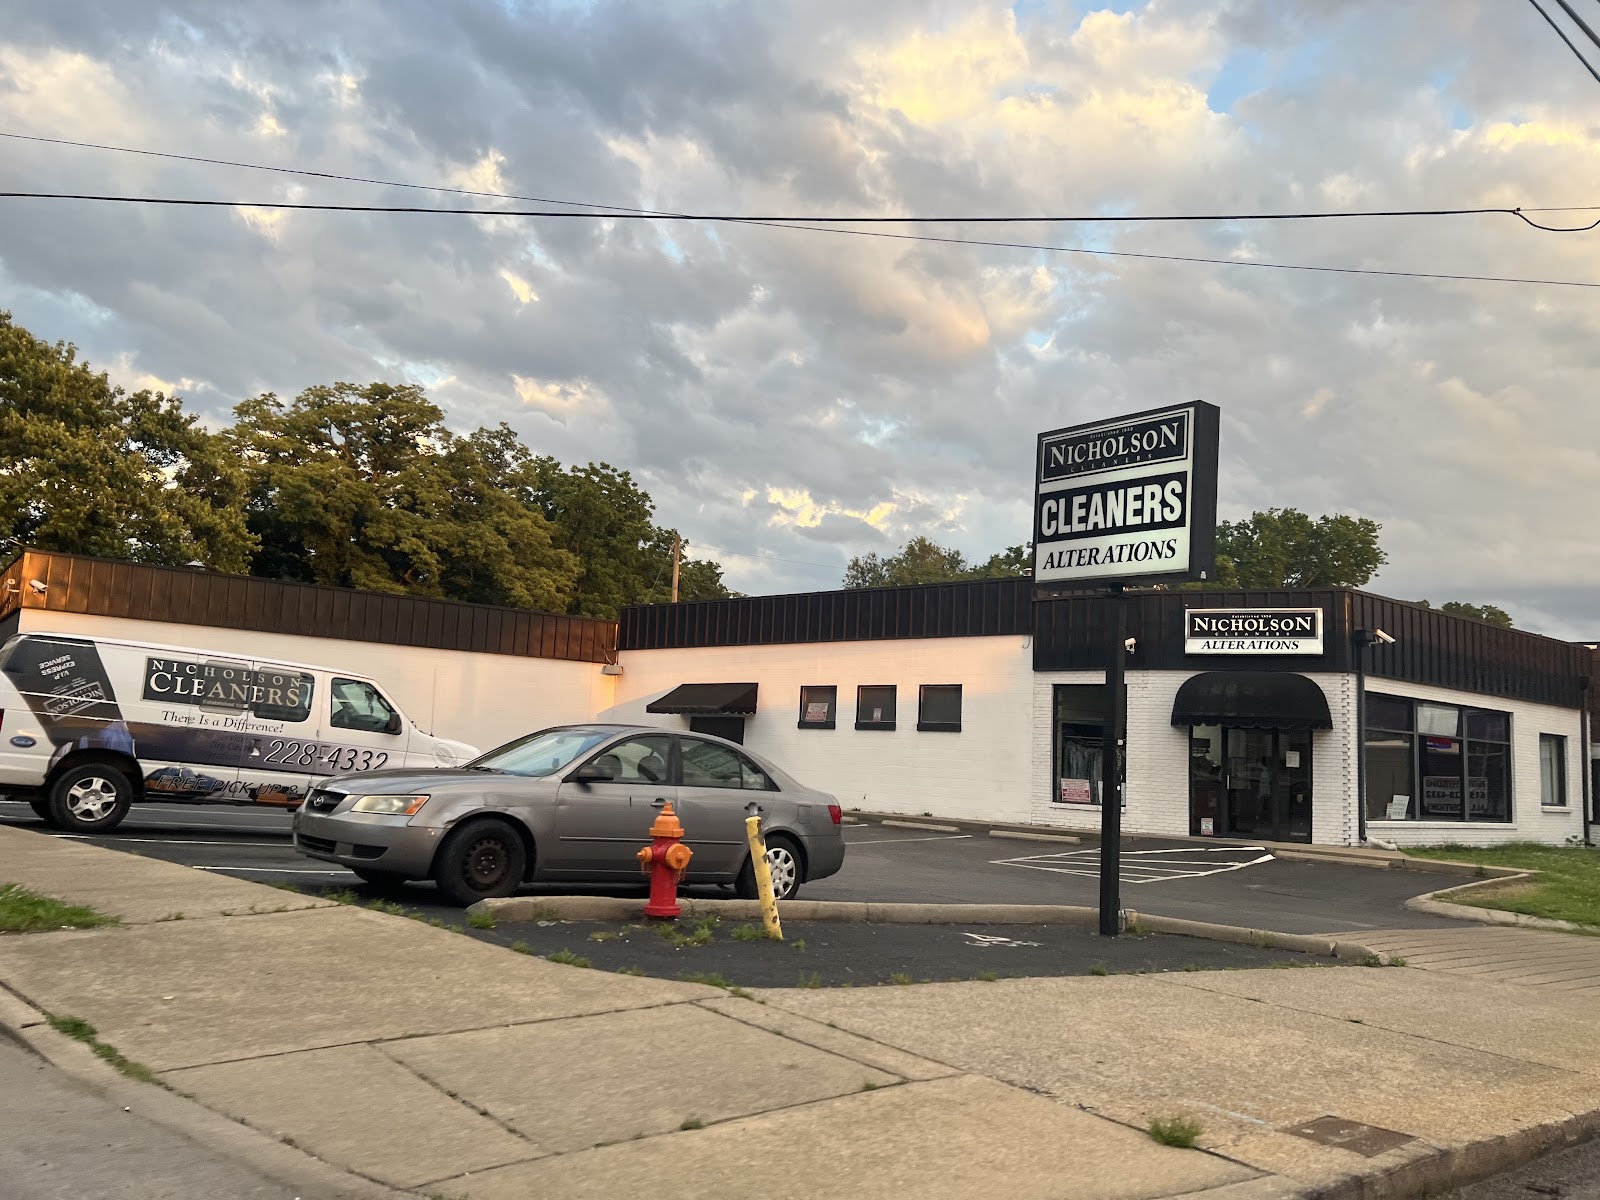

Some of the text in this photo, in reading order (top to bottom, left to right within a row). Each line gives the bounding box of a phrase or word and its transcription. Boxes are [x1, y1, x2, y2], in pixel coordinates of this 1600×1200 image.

[1050, 422, 1180, 468] NICHOLSON
[1070, 453, 1153, 473] CLEANERS
[1041, 480, 1183, 537] CLEANERS
[1042, 538, 1178, 570] ALTERATIONS
[1193, 616, 1312, 632] NICHOLSON
[1201, 640, 1300, 650] ALTERATIONS
[38, 654, 71, 670] SERVICE
[41, 660, 76, 676] EXPRESS
[152, 660, 301, 688] NICHOLSON
[150, 672, 301, 707] CLEANERS
[162, 710, 285, 733] There Is a Difference!
[264, 740, 389, 771] 228-4332
[156, 775, 207, 791] FREE
[209, 779, 253, 795] PICK
[256, 783, 282, 796] UP
